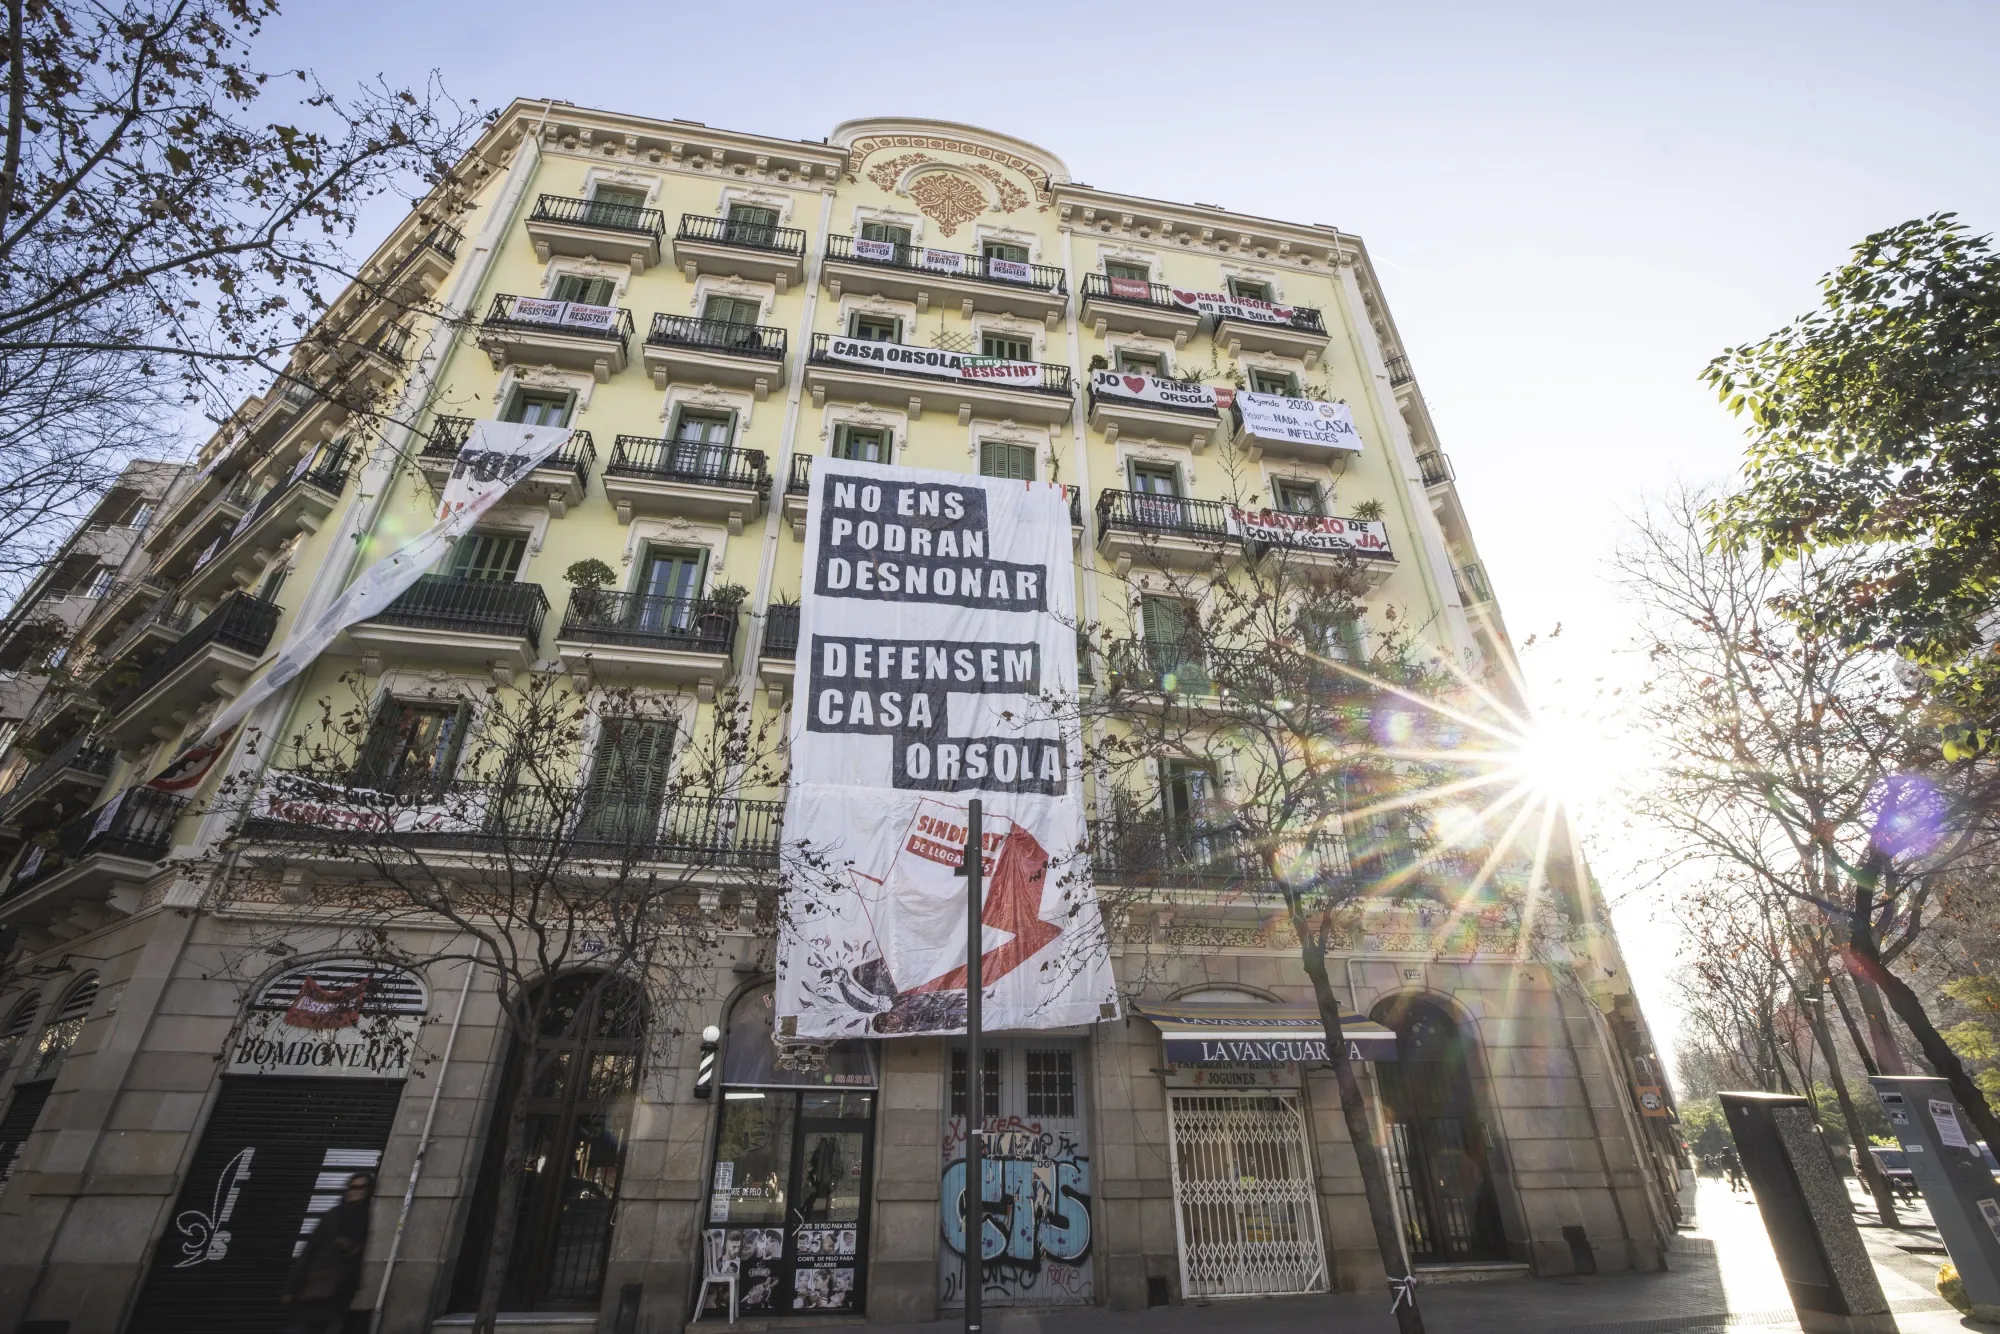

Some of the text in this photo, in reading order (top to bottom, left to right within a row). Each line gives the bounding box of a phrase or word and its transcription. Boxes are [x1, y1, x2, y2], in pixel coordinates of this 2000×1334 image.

[927, 255, 959, 267] RESISTEIX
[994, 266, 1027, 277] RESISTEIX
[1196, 292, 1273, 311] CASA ORSOLA
[517, 305, 559, 318] RESISTEIX
[569, 311, 609, 324] RESISTEIX
[1199, 302, 1214, 312] NO
[1248, 310, 1276, 322] SOLA
[833, 340, 962, 370] CASA ORSOLA
[963, 357, 1010, 368] 2 anys
[961, 365, 1038, 378] RESISTINT
[1098, 372, 1120, 387] JO
[1160, 391, 1215, 404] ORSOLA
[1286, 399, 1314, 411] 2030
[1314, 419, 1353, 435] CASA
[1287, 427, 1339, 444] INFELICES
[834, 481, 965, 520] NO ENS
[1348, 520, 1368, 533] DE
[830, 517, 985, 559] PODRAN
[826, 556, 1038, 601] DESNONAR
[822, 641, 1033, 683] DEFENSEM
[817, 688, 933, 729] CASA
[905, 742, 1062, 784] ORSOLA
[917, 814, 1005, 852] SINDIAT
[912, 840, 926, 853] DE
[1208, 1072, 1256, 1085] JOGUINES
[749, 1187, 761, 1196] PELO
